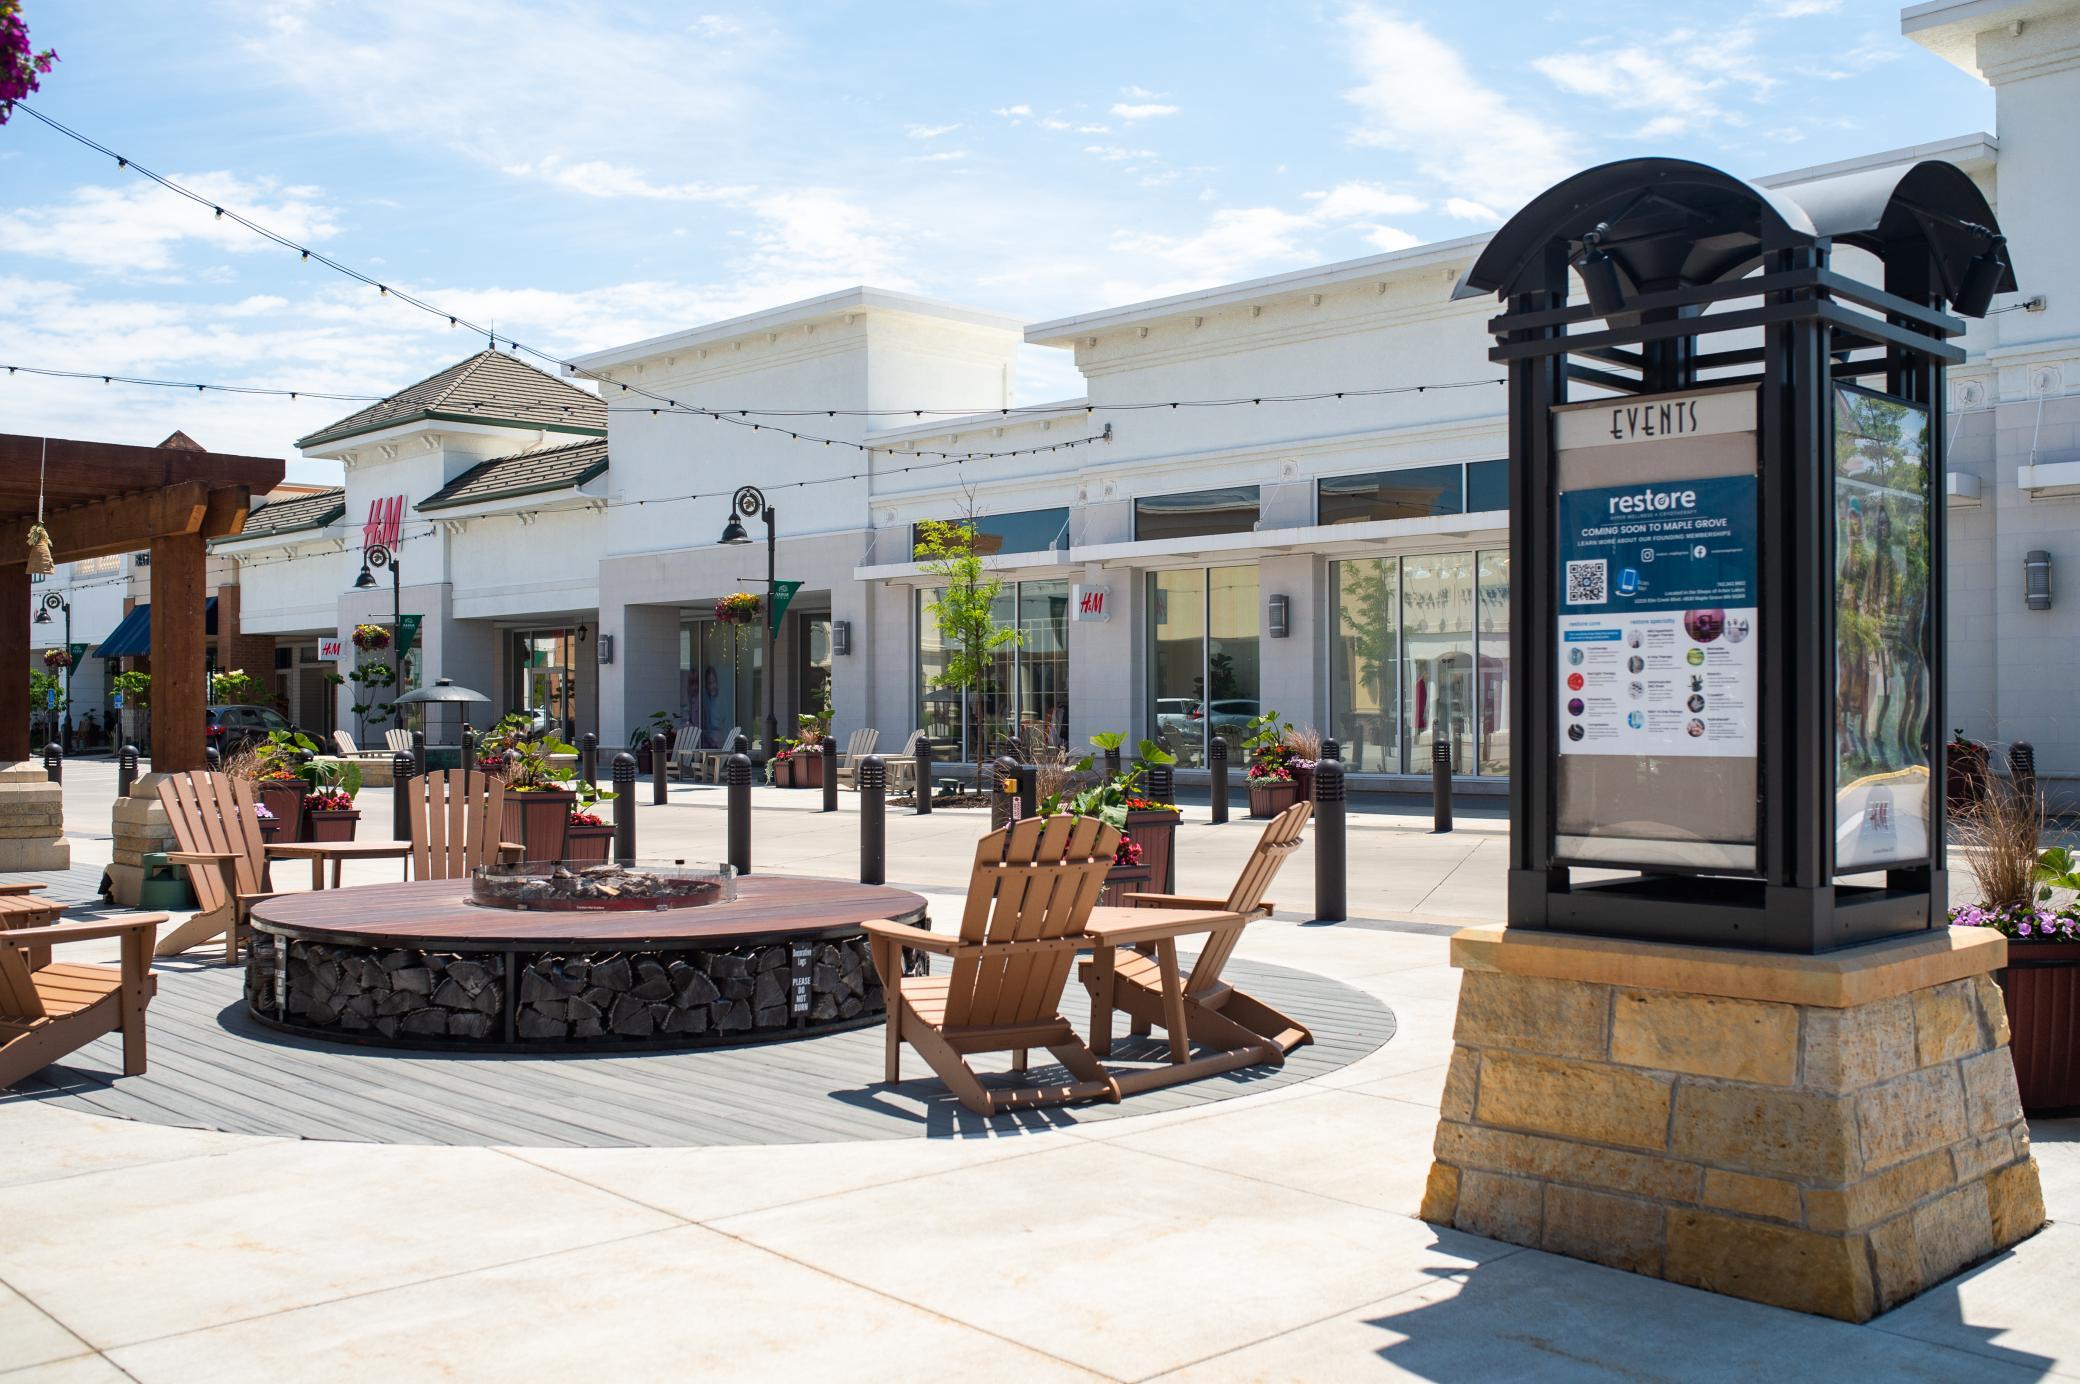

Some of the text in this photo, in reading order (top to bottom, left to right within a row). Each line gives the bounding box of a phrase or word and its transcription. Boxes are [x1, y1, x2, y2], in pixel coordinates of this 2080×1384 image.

[1610, 400, 1697, 440] EVENTS
[1609, 489, 1697, 514] restore
[362, 494, 403, 554] H&M
[1581, 518, 1728, 536] COMING SOON TO MAPLE GROVE
[1652, 533, 1684, 541] FOUNDING
[1686, 530, 1732, 539] MEMBERSHIPS
[1080, 591, 1104, 615] H&M
[321, 642, 341, 656] H&M
[797, 957, 807, 967] Logs
[792, 977, 811, 986] PLEASE
[797, 986, 805, 994] DO
[796, 994, 807, 1003] NOT
[794, 1003, 809, 1012] BURN
